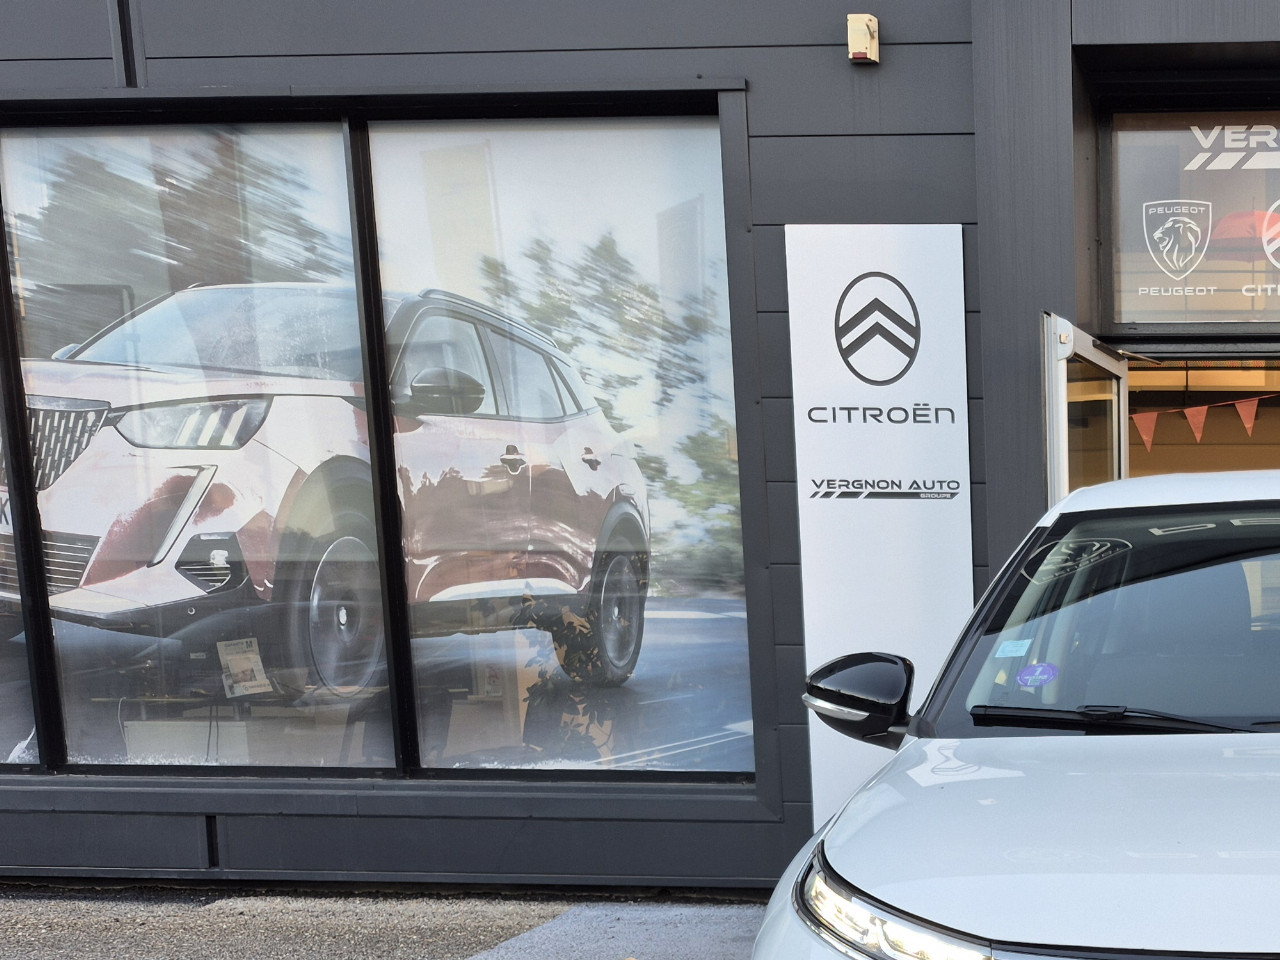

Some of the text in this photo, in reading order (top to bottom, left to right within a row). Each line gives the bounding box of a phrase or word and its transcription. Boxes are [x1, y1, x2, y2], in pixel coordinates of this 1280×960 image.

[1148, 206, 1206, 215] PEUGEOT
[1138, 286, 1217, 296] PEUGEOT
[811, 479, 960, 491] VERGNON AUTO
